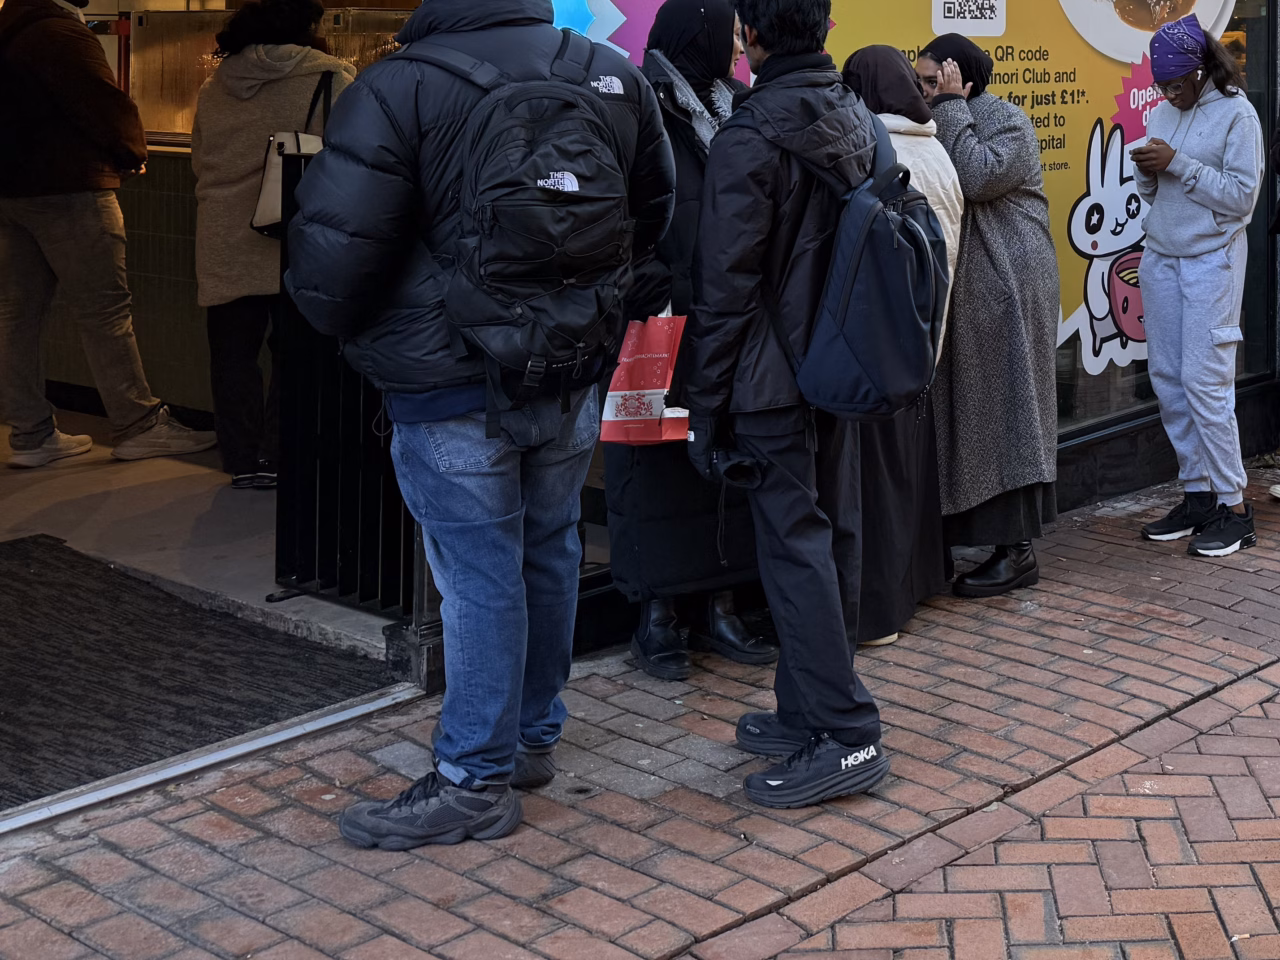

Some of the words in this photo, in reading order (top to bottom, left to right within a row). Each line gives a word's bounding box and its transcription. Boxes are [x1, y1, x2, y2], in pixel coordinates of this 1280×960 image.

[994, 46, 1015, 61] QR
[1018, 45, 1049, 61] code
[1022, 67, 1050, 84] Club
[1054, 67, 1076, 83] and
[1007, 91, 1027, 107] for
[1030, 90, 1057, 109] just
[1053, 114, 1065, 128] to
[1048, 161, 1071, 172] store.
[537, 178, 564, 187] NORTH
[549, 171, 564, 179] THE
[841, 744, 877, 770] HOKA
